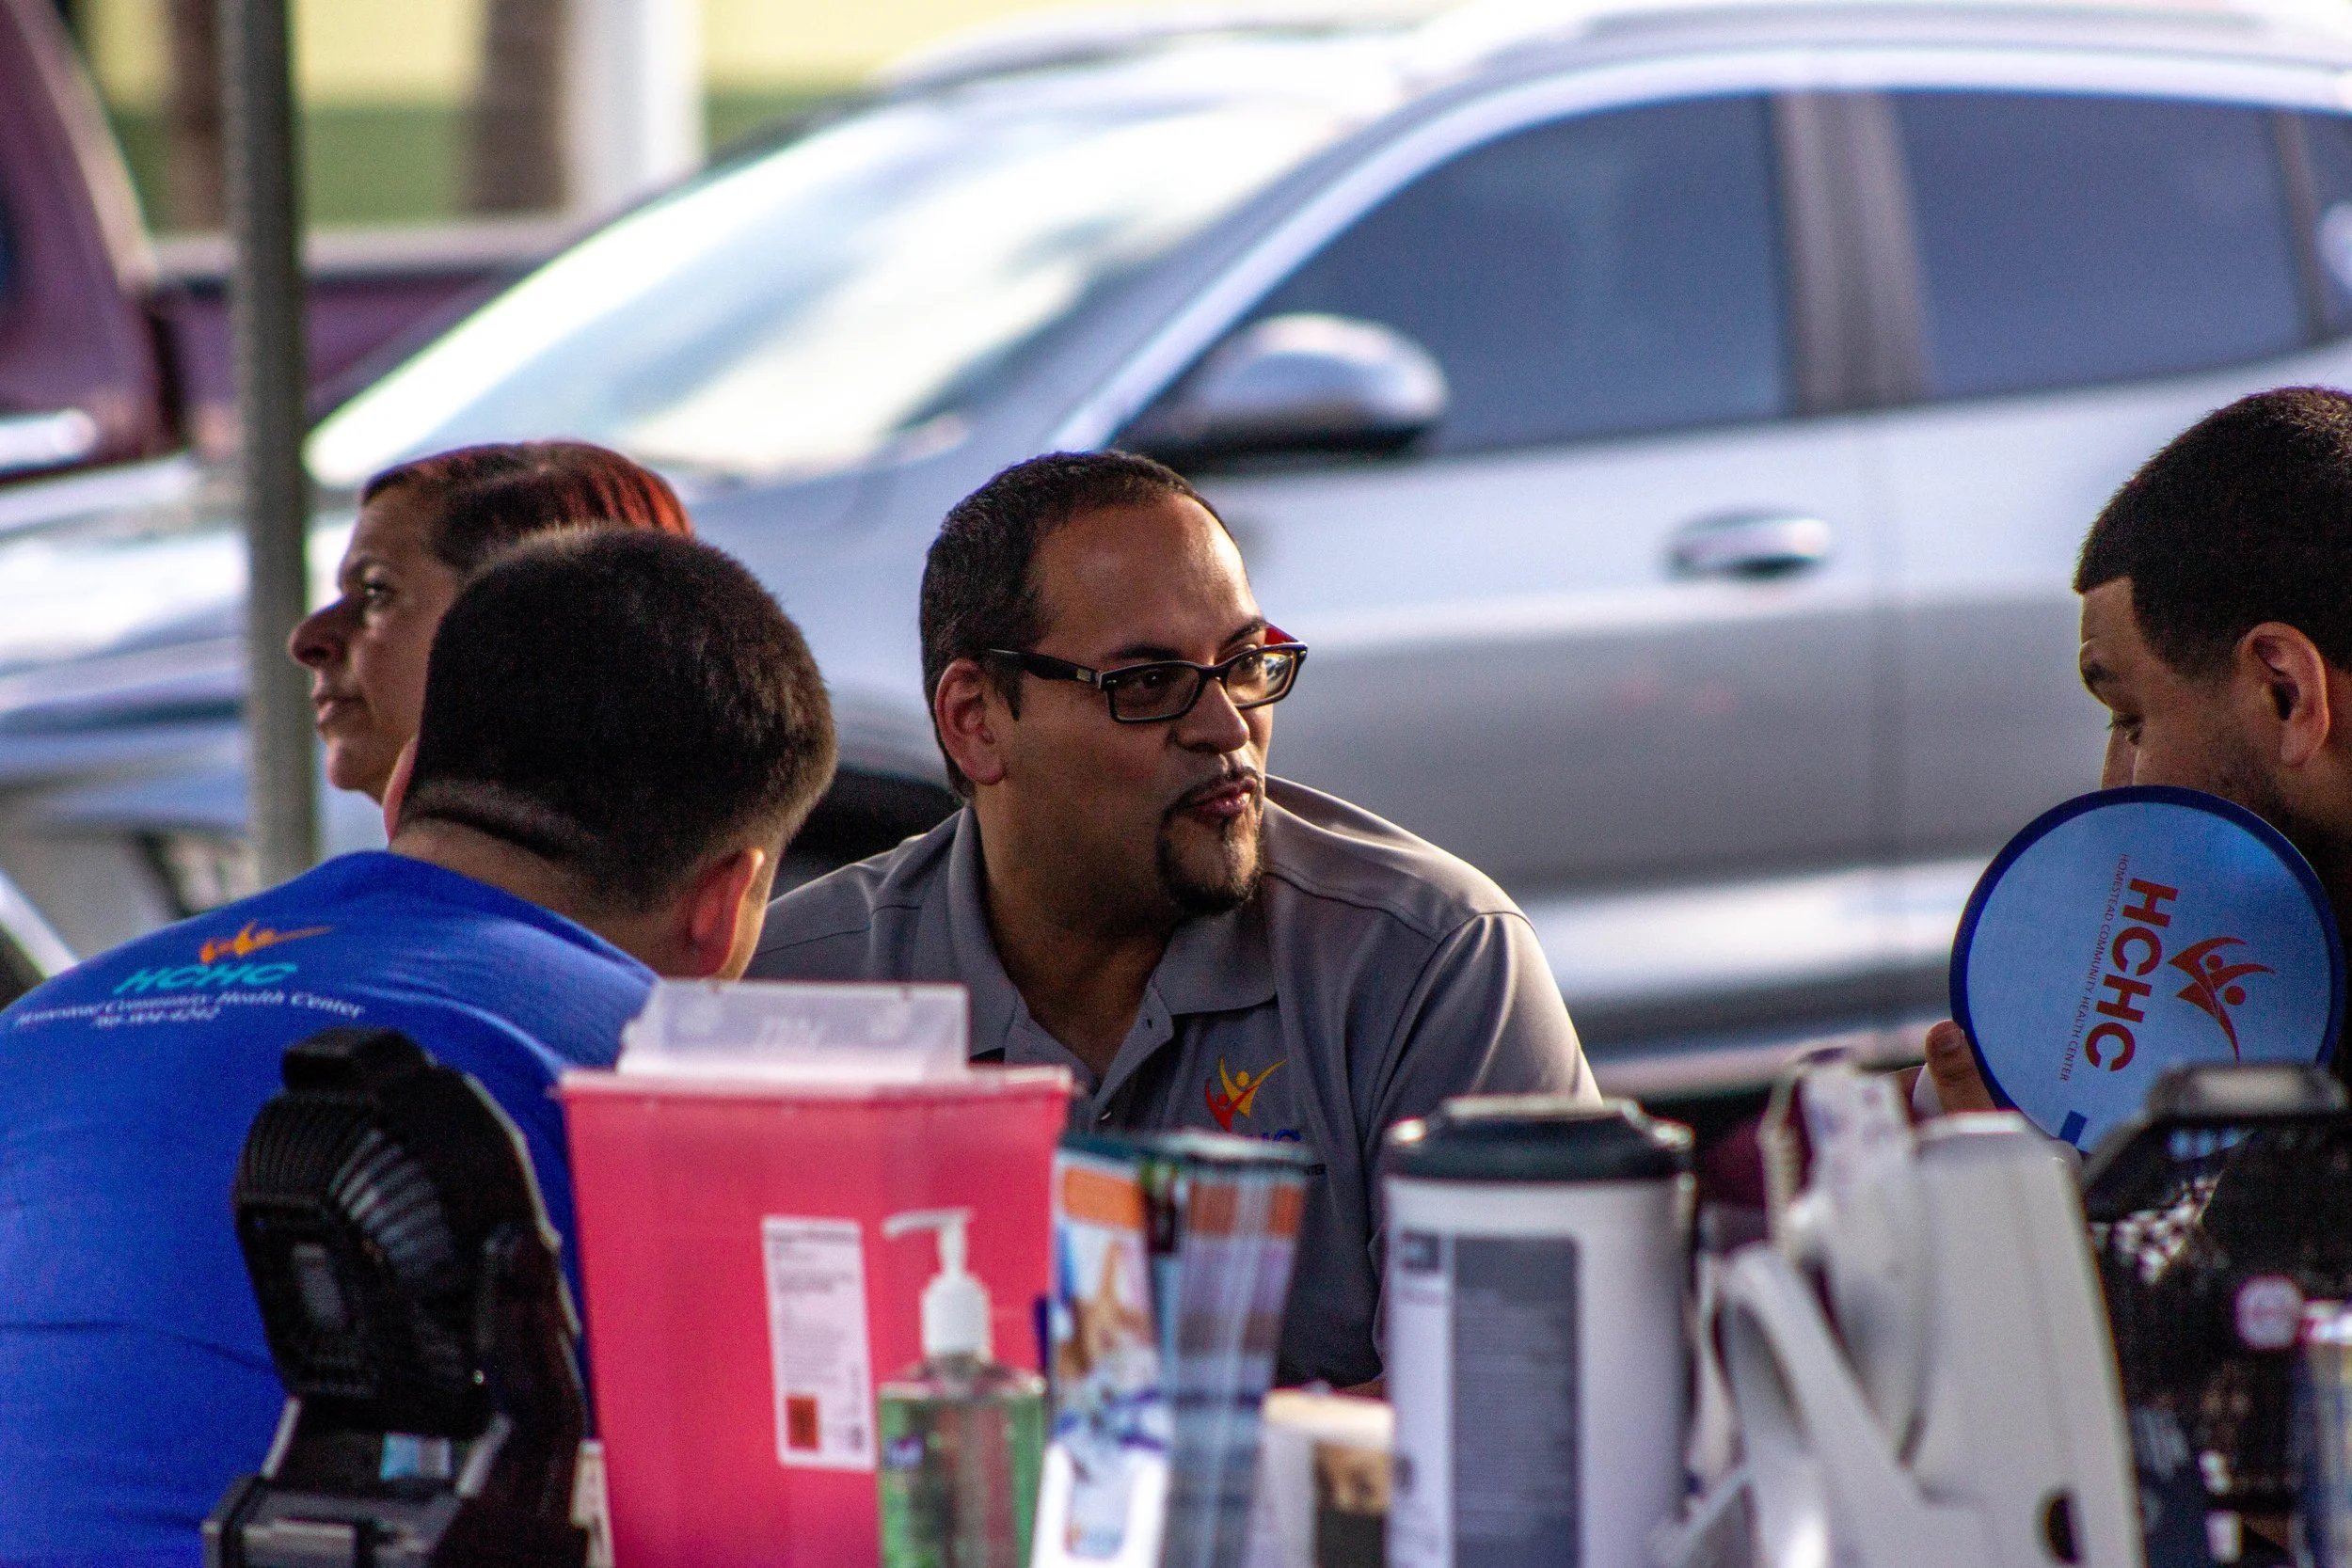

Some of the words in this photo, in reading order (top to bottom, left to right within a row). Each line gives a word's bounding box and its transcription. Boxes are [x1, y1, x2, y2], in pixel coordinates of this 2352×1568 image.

[2104, 853, 2131, 922] HOMESTEAD
[112, 962, 298, 995] HCHC
[2085, 924, 2111, 994] COMMUNITY
[2085, 878, 2179, 1071] HCHC
[291, 991, 365, 1018] Center
[2072, 996, 2090, 1038] HEALTH
[2060, 1040, 2078, 1082] CENTER
